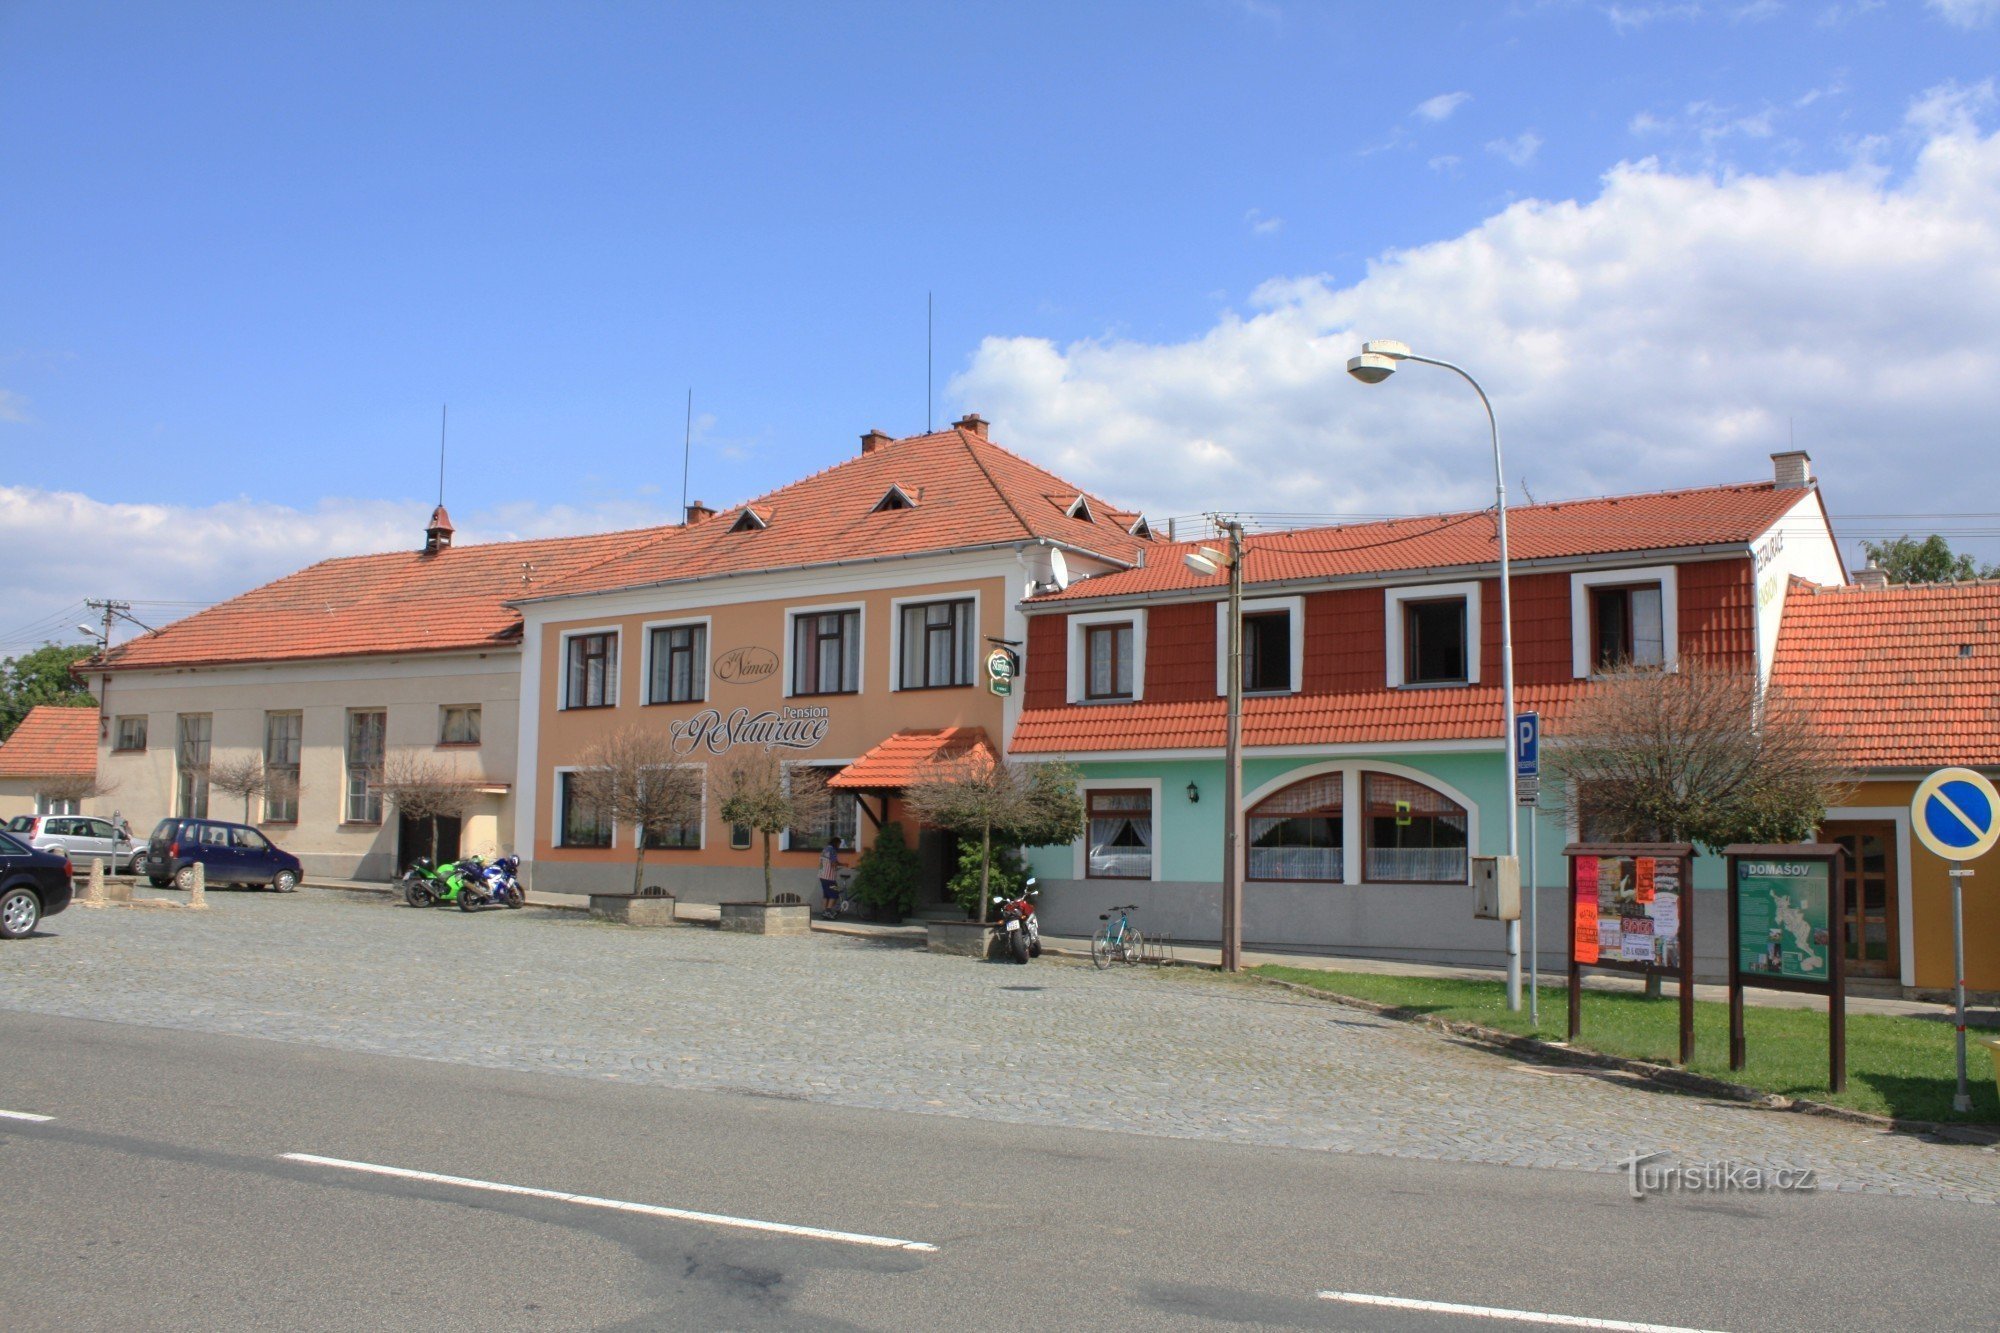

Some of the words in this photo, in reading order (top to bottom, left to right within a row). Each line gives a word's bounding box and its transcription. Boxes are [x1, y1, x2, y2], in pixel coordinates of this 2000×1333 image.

[783, 705, 829, 719] Pension
[1519, 721, 1533, 757] P
[1748, 862, 1810, 877] DOMAŠOV
